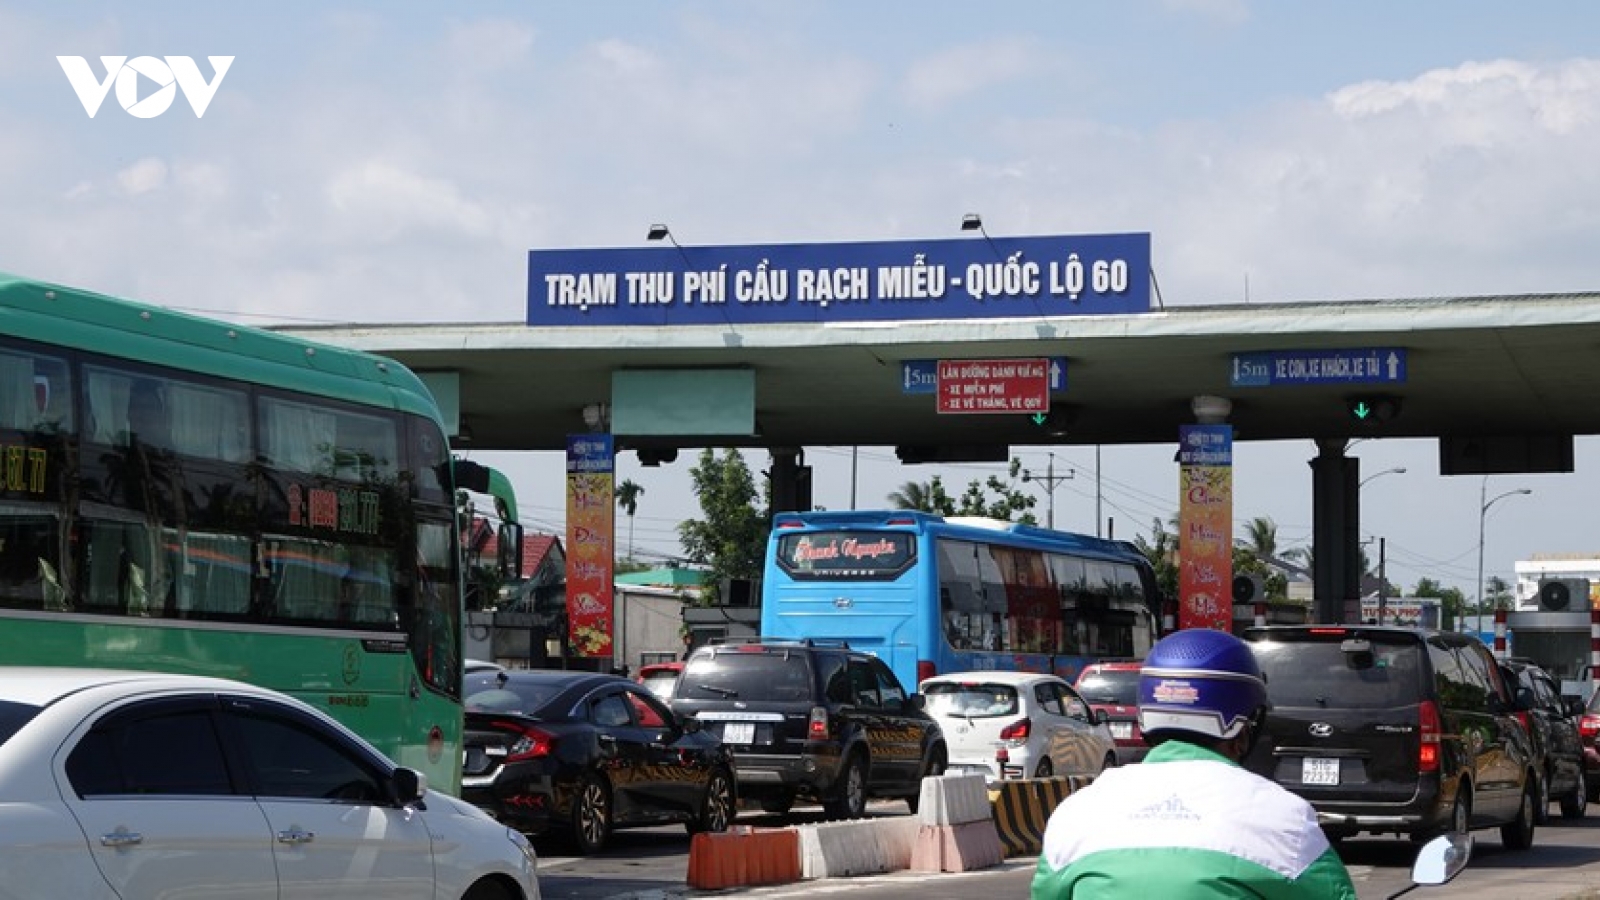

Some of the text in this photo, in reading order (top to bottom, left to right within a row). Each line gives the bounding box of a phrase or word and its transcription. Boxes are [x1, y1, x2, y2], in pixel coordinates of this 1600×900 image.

[545, 273, 617, 311] TRẠM
[625, 272, 675, 305] THU
[684, 263, 727, 304] PHÍ
[735, 258, 787, 302] CẦU
[797, 266, 869, 307] RẠCH
[877, 253, 946, 300] MIỄU
[966, 251, 1040, 300] QUỐC
[1050, 252, 1084, 300] LỘ
[1091, 259, 1128, 294] 60
[1241, 360, 1268, 377] 5m
